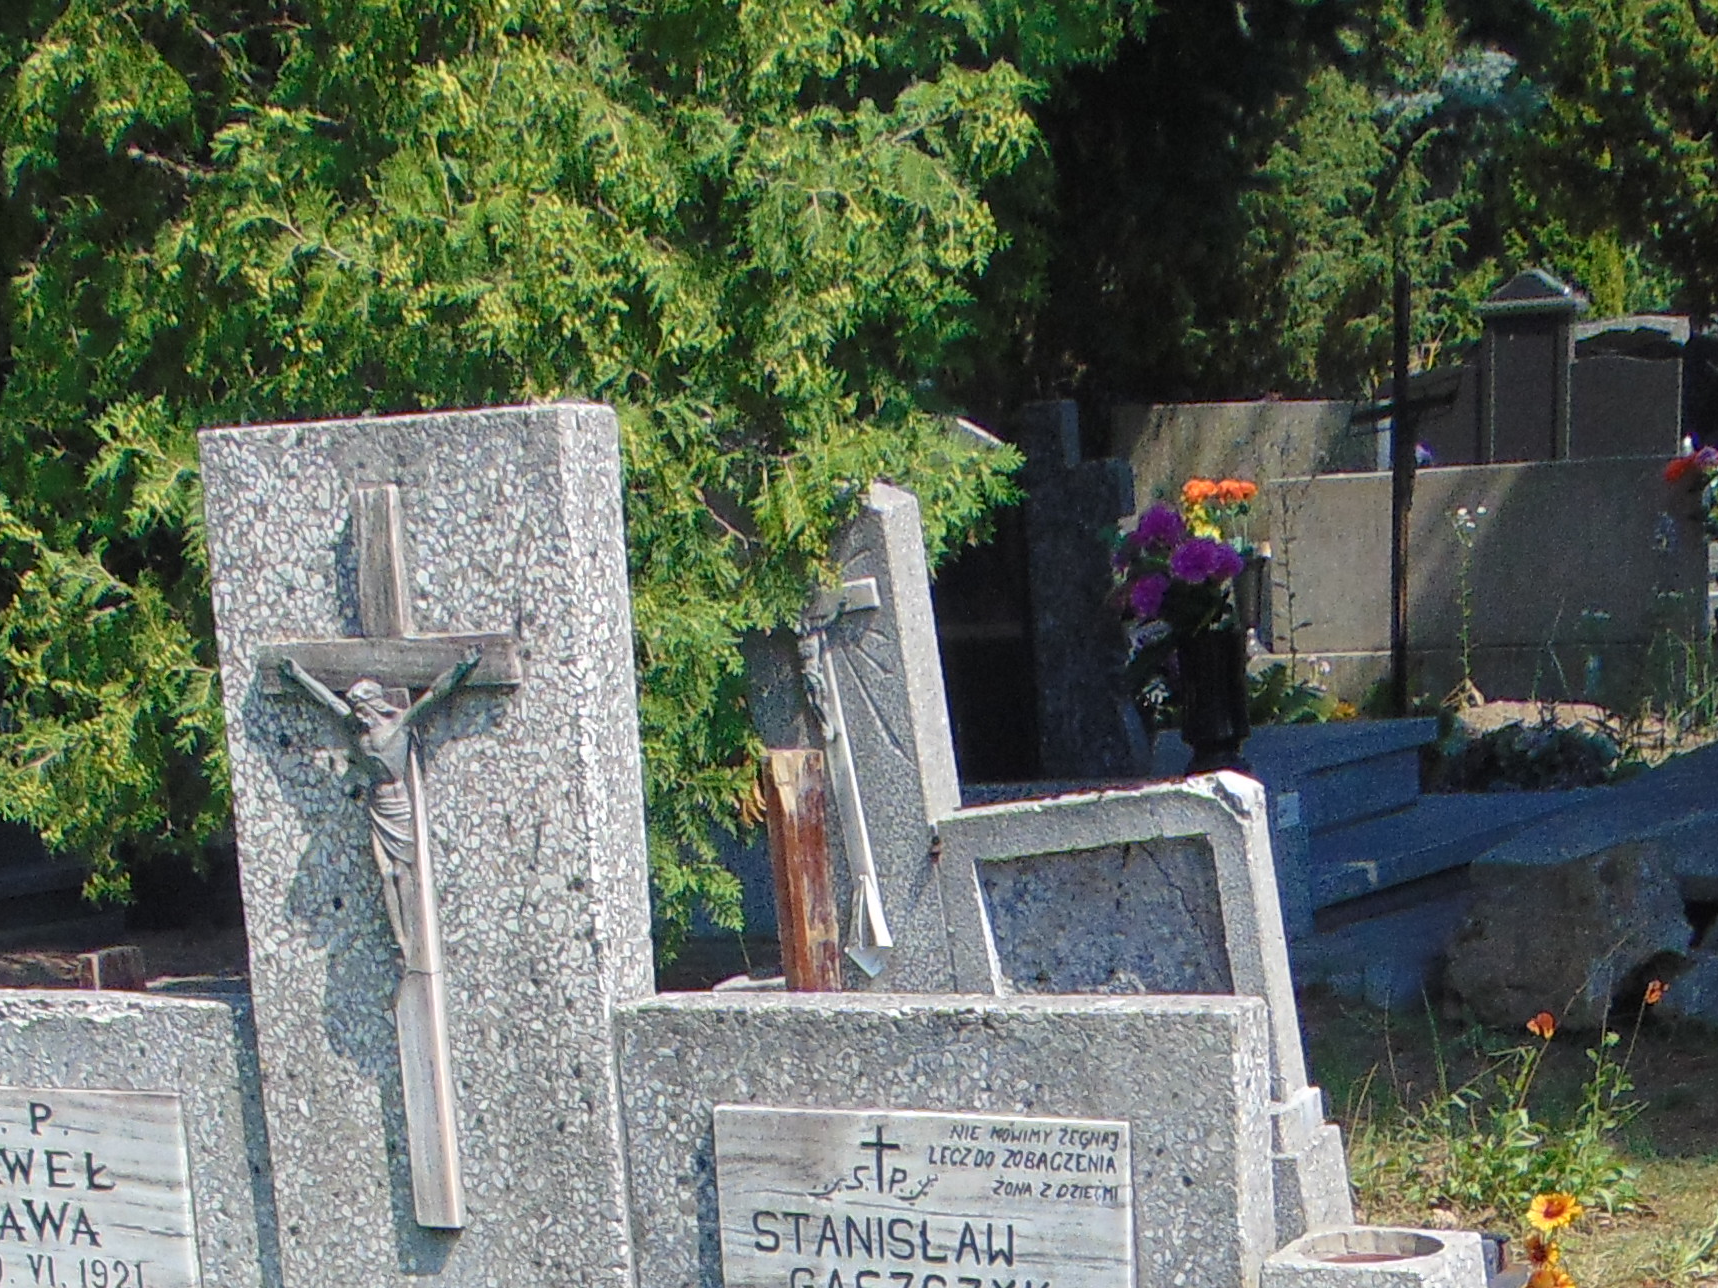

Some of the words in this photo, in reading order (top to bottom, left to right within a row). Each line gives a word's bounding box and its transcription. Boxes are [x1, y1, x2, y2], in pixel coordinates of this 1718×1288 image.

[950, 1124, 981, 1142] NIE
[1001, 1148, 1118, 1175] ZOBACZENIA
[752, 1209, 1015, 1268] STANISŁAW
